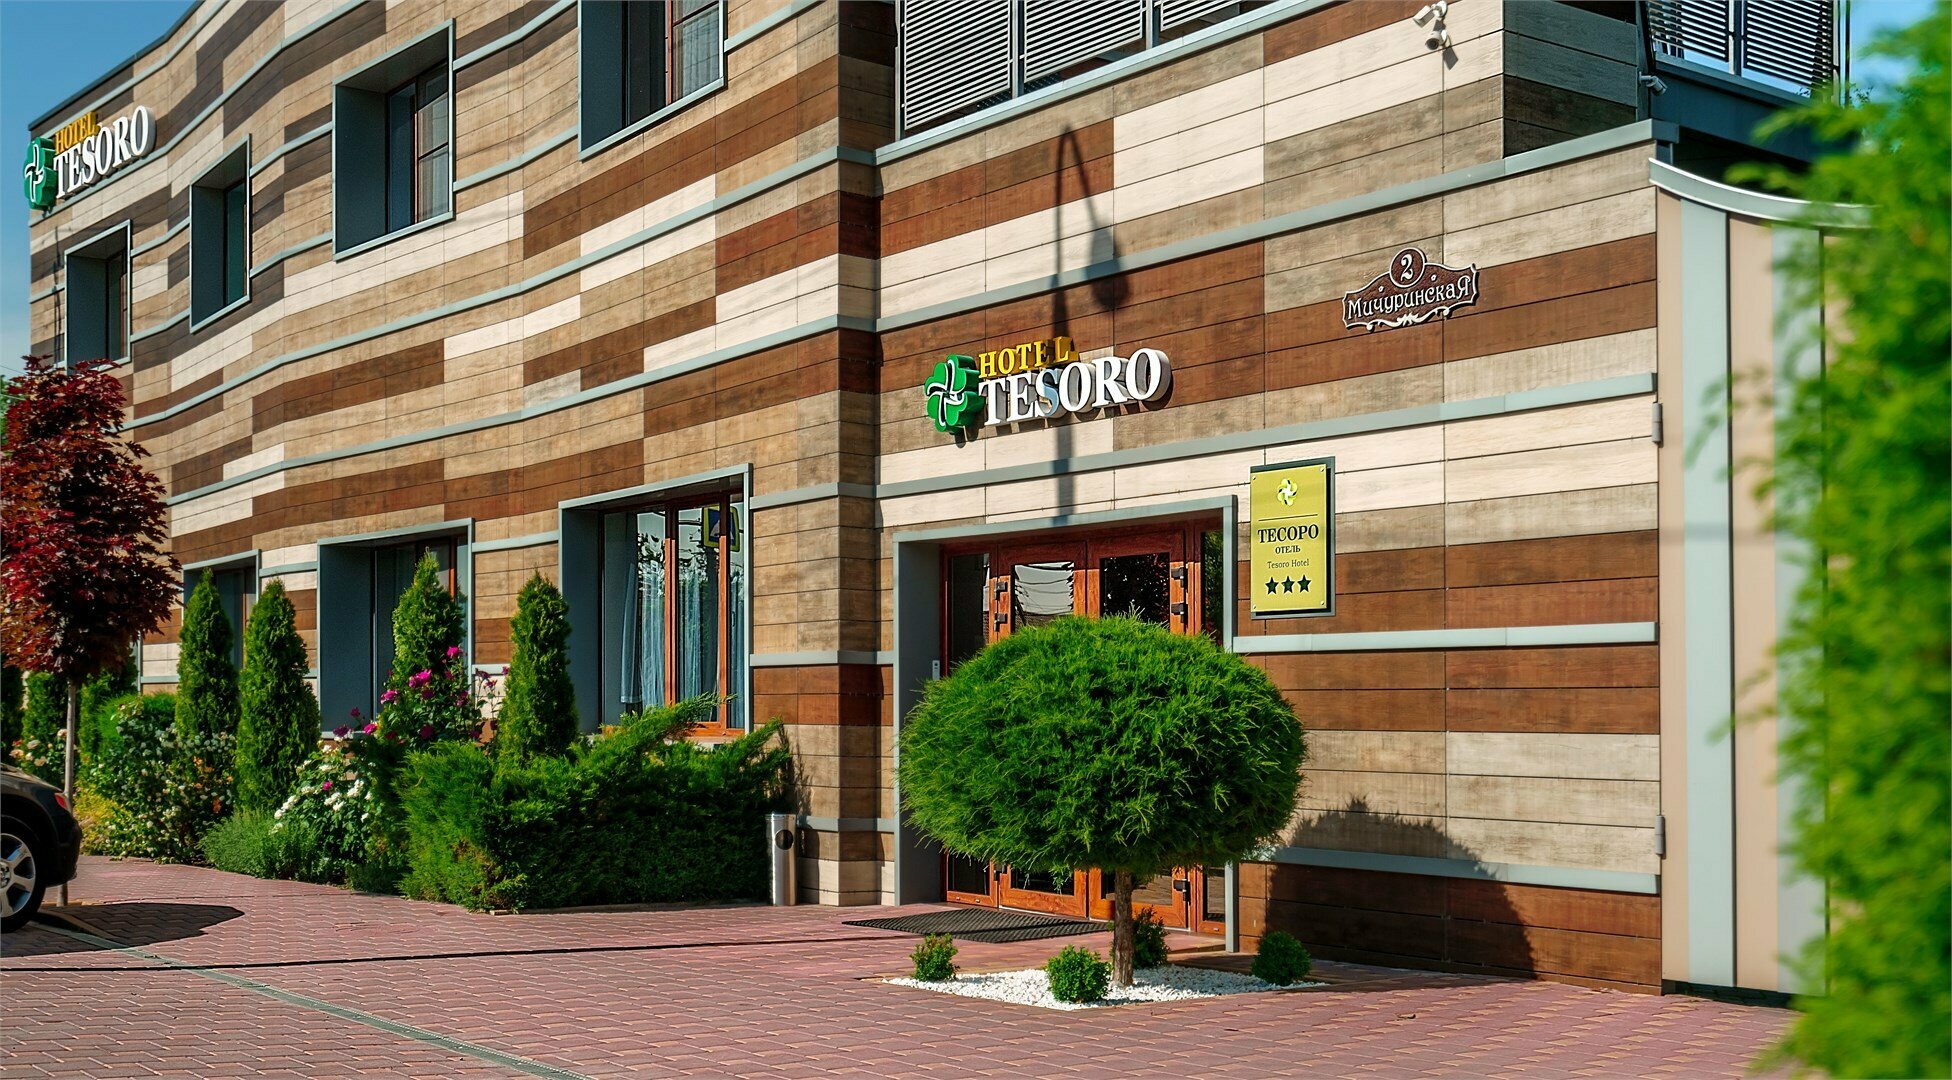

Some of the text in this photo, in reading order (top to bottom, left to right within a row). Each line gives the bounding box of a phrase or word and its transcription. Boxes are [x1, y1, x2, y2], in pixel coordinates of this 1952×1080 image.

[53, 105, 154, 198] TESORO
[55, 111, 99, 154] HOTEL
[1400, 253, 1414, 282] 2
[978, 336, 1076, 379] HOTEL
[978, 348, 1168, 426] TESORO
[1258, 524, 1319, 543] ТЕСОРО
[1267, 559, 1309, 569] Tesoro Hotel
